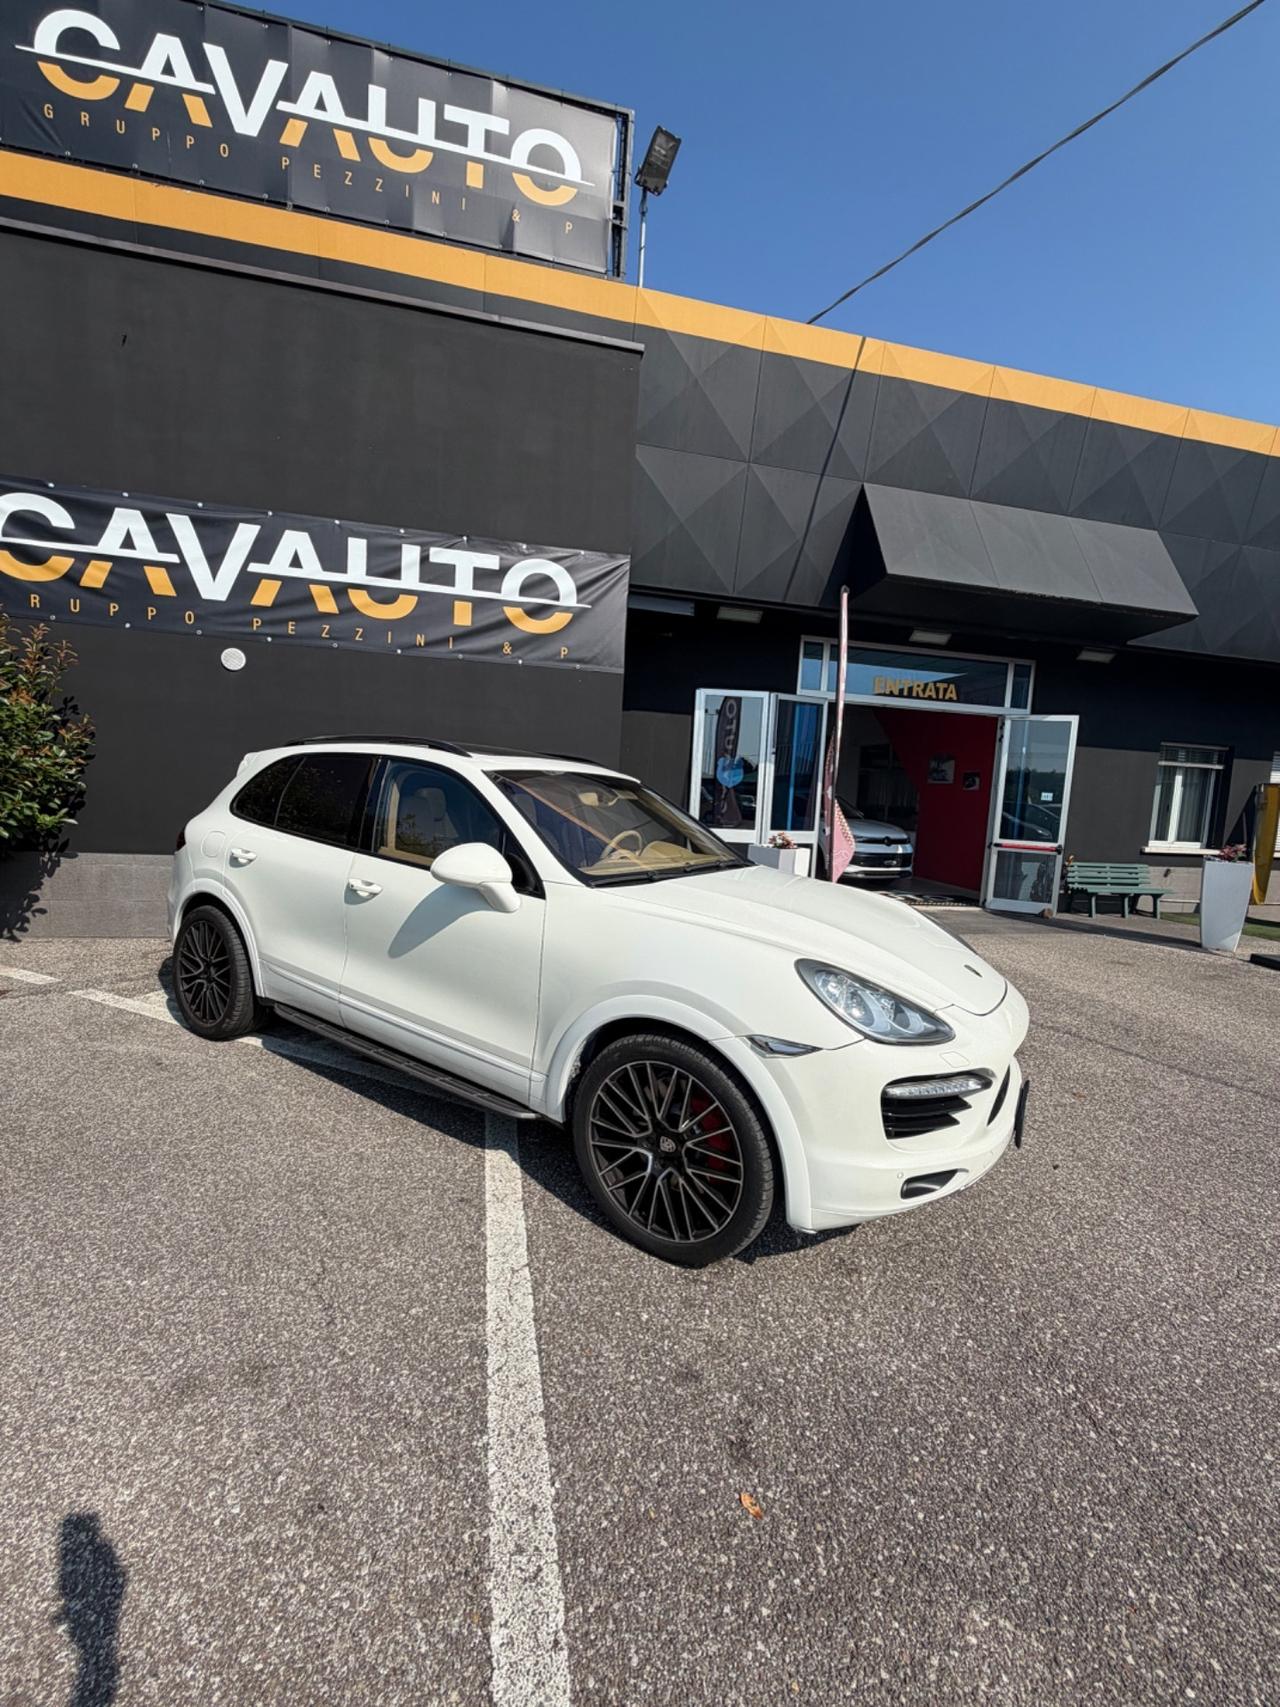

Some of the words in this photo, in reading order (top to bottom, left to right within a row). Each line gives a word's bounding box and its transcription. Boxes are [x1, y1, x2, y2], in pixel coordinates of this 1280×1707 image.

[15, 9, 595, 206] CAVAUTO
[44, 103, 229, 158] GRUPPO
[281, 157, 466, 210] PEZZINI
[511, 209, 521, 223] &
[564, 221, 573, 234] P
[0, 492, 591, 634] CAVAUTO
[30, 594, 195, 625] RUPPO
[252, 617, 453, 650] PEZZINI
[502, 641, 512, 654] &
[560, 646, 568, 658] P
[874, 676, 957, 700] ENTRATA
